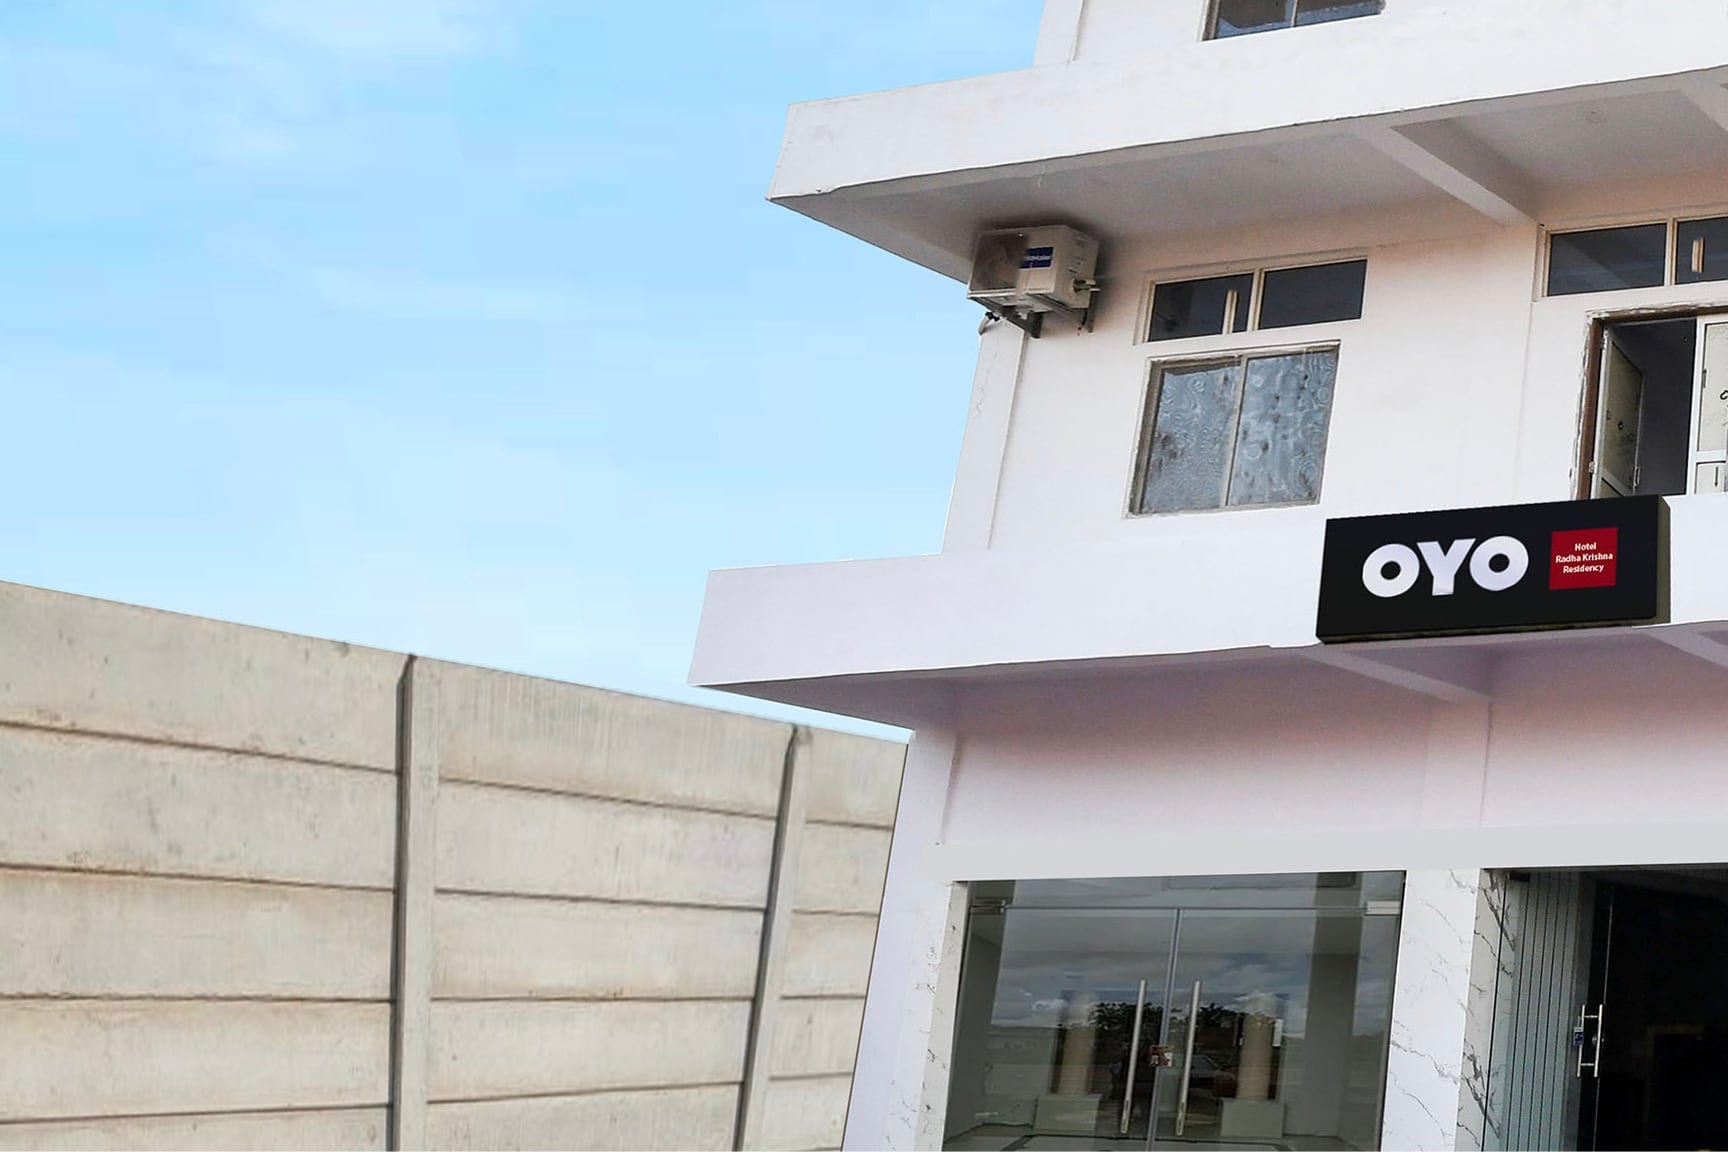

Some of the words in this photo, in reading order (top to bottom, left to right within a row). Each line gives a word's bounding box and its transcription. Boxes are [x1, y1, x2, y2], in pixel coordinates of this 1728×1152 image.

[1574, 542, 1597, 551] Hotel
[1555, 554, 1581, 563] Radha
[1582, 552, 1613, 561] Krishna
[1362, 535, 1529, 598] OYO
[1562, 564, 1604, 573] Residency
